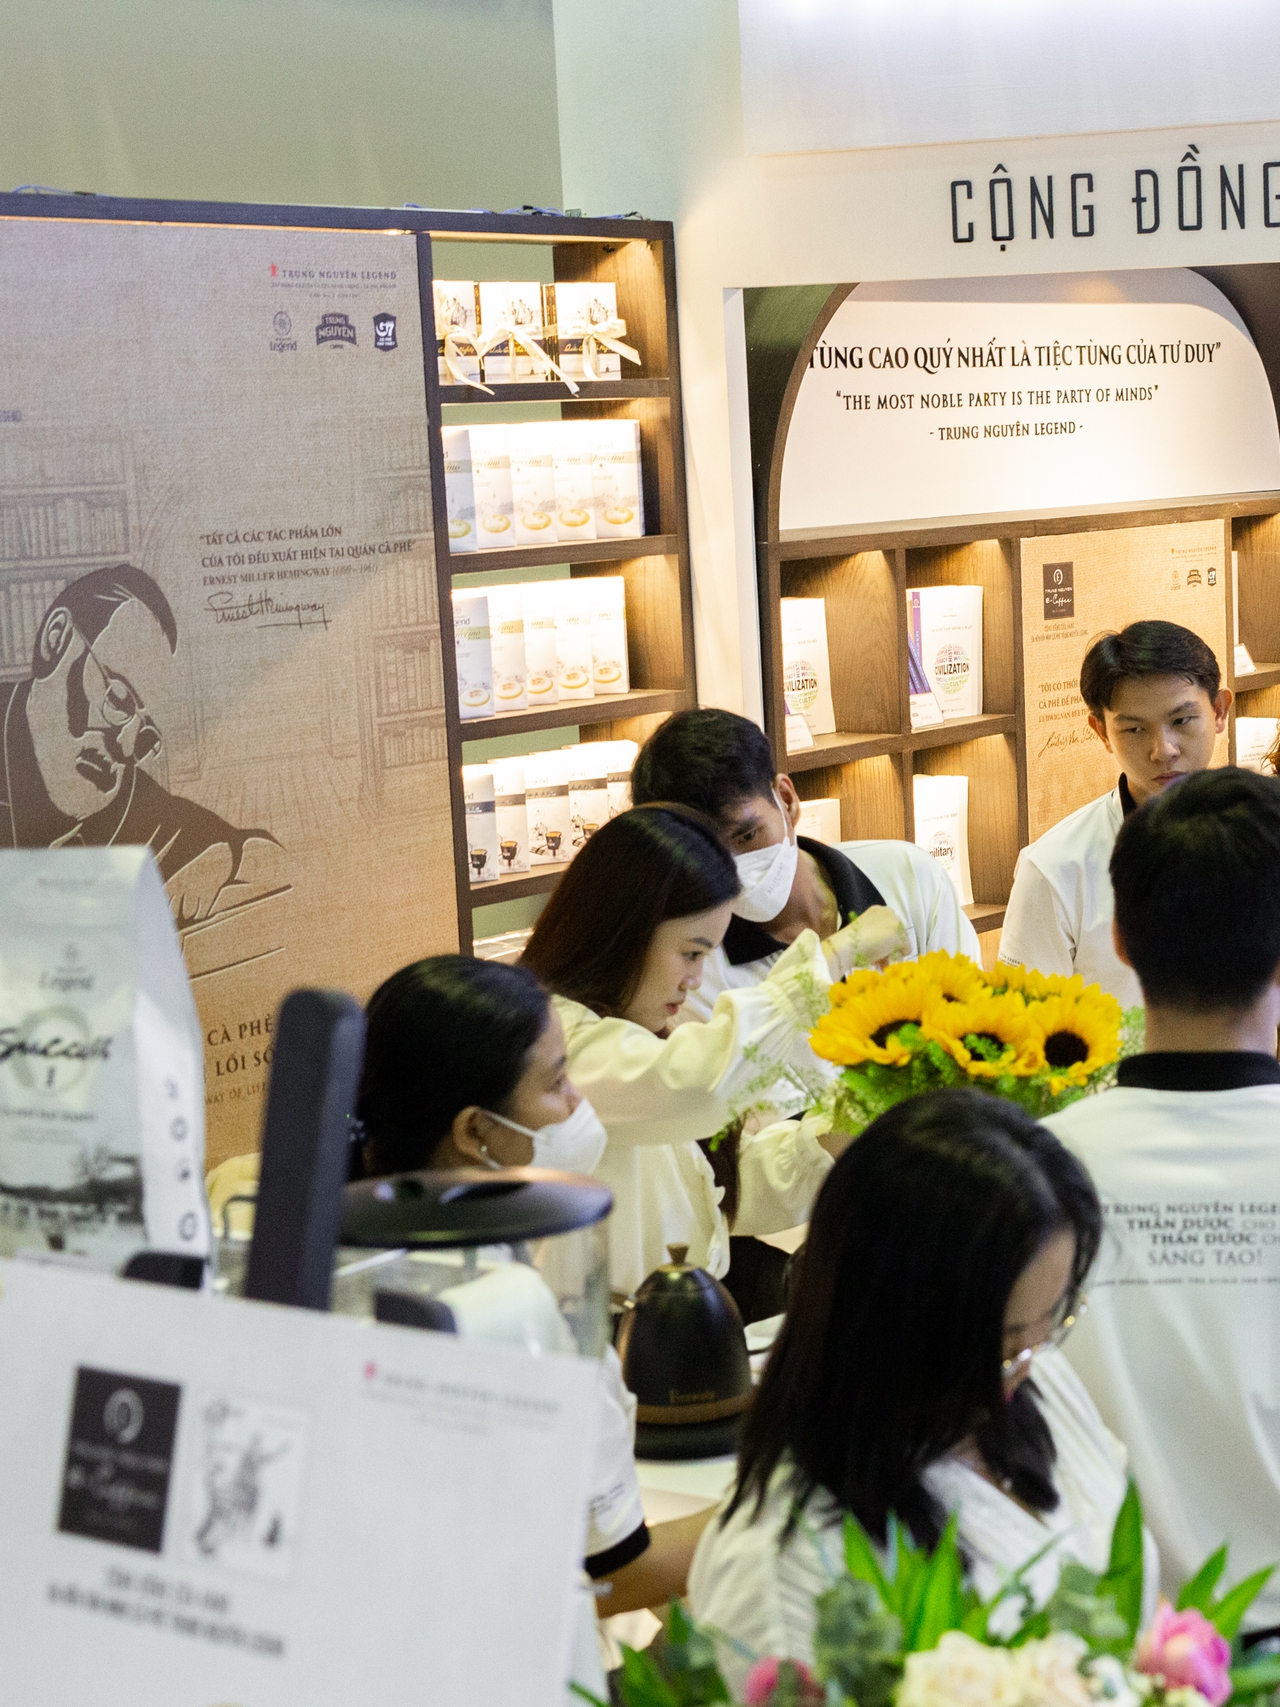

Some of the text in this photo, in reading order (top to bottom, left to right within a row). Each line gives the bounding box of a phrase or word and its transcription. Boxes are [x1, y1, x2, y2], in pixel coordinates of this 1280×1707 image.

[951, 163, 1094, 251] CỘNG
[282, 270, 315, 279] TRUNG
[361, 270, 397, 280] LEGEND
[869, 347, 909, 369] CAO
[914, 338, 953, 374] QUÝ
[958, 337, 1006, 367] NHẤT
[1011, 340, 1031, 366] LÀ
[1034, 342, 1073, 371] TIỆC
[1075, 340, 1122, 366] TÙNG
[1126, 339, 1157, 364] CỦA
[877, 394, 914, 409] MOST
[921, 393, 963, 408] NOBLE
[969, 392, 1006, 407] PARTY
[1012, 391, 1022, 405] IS
[1027, 391, 1051, 405] THE
[1057, 389, 1091, 403] PARTY
[1096, 388, 1110, 402] OF
[938, 421, 1075, 440] TRUNG NGUYÊN LEGEND
[203, 574, 238, 586] ERNEST
[241, 570, 275, 583] MILLER
[277, 568, 330, 580] HEMINGWAY
[935, 662, 970, 676] CIVILIZATION
[207, 1014, 273, 1046] CÀ PHÊ
[216, 1052, 246, 1076] LỐI
